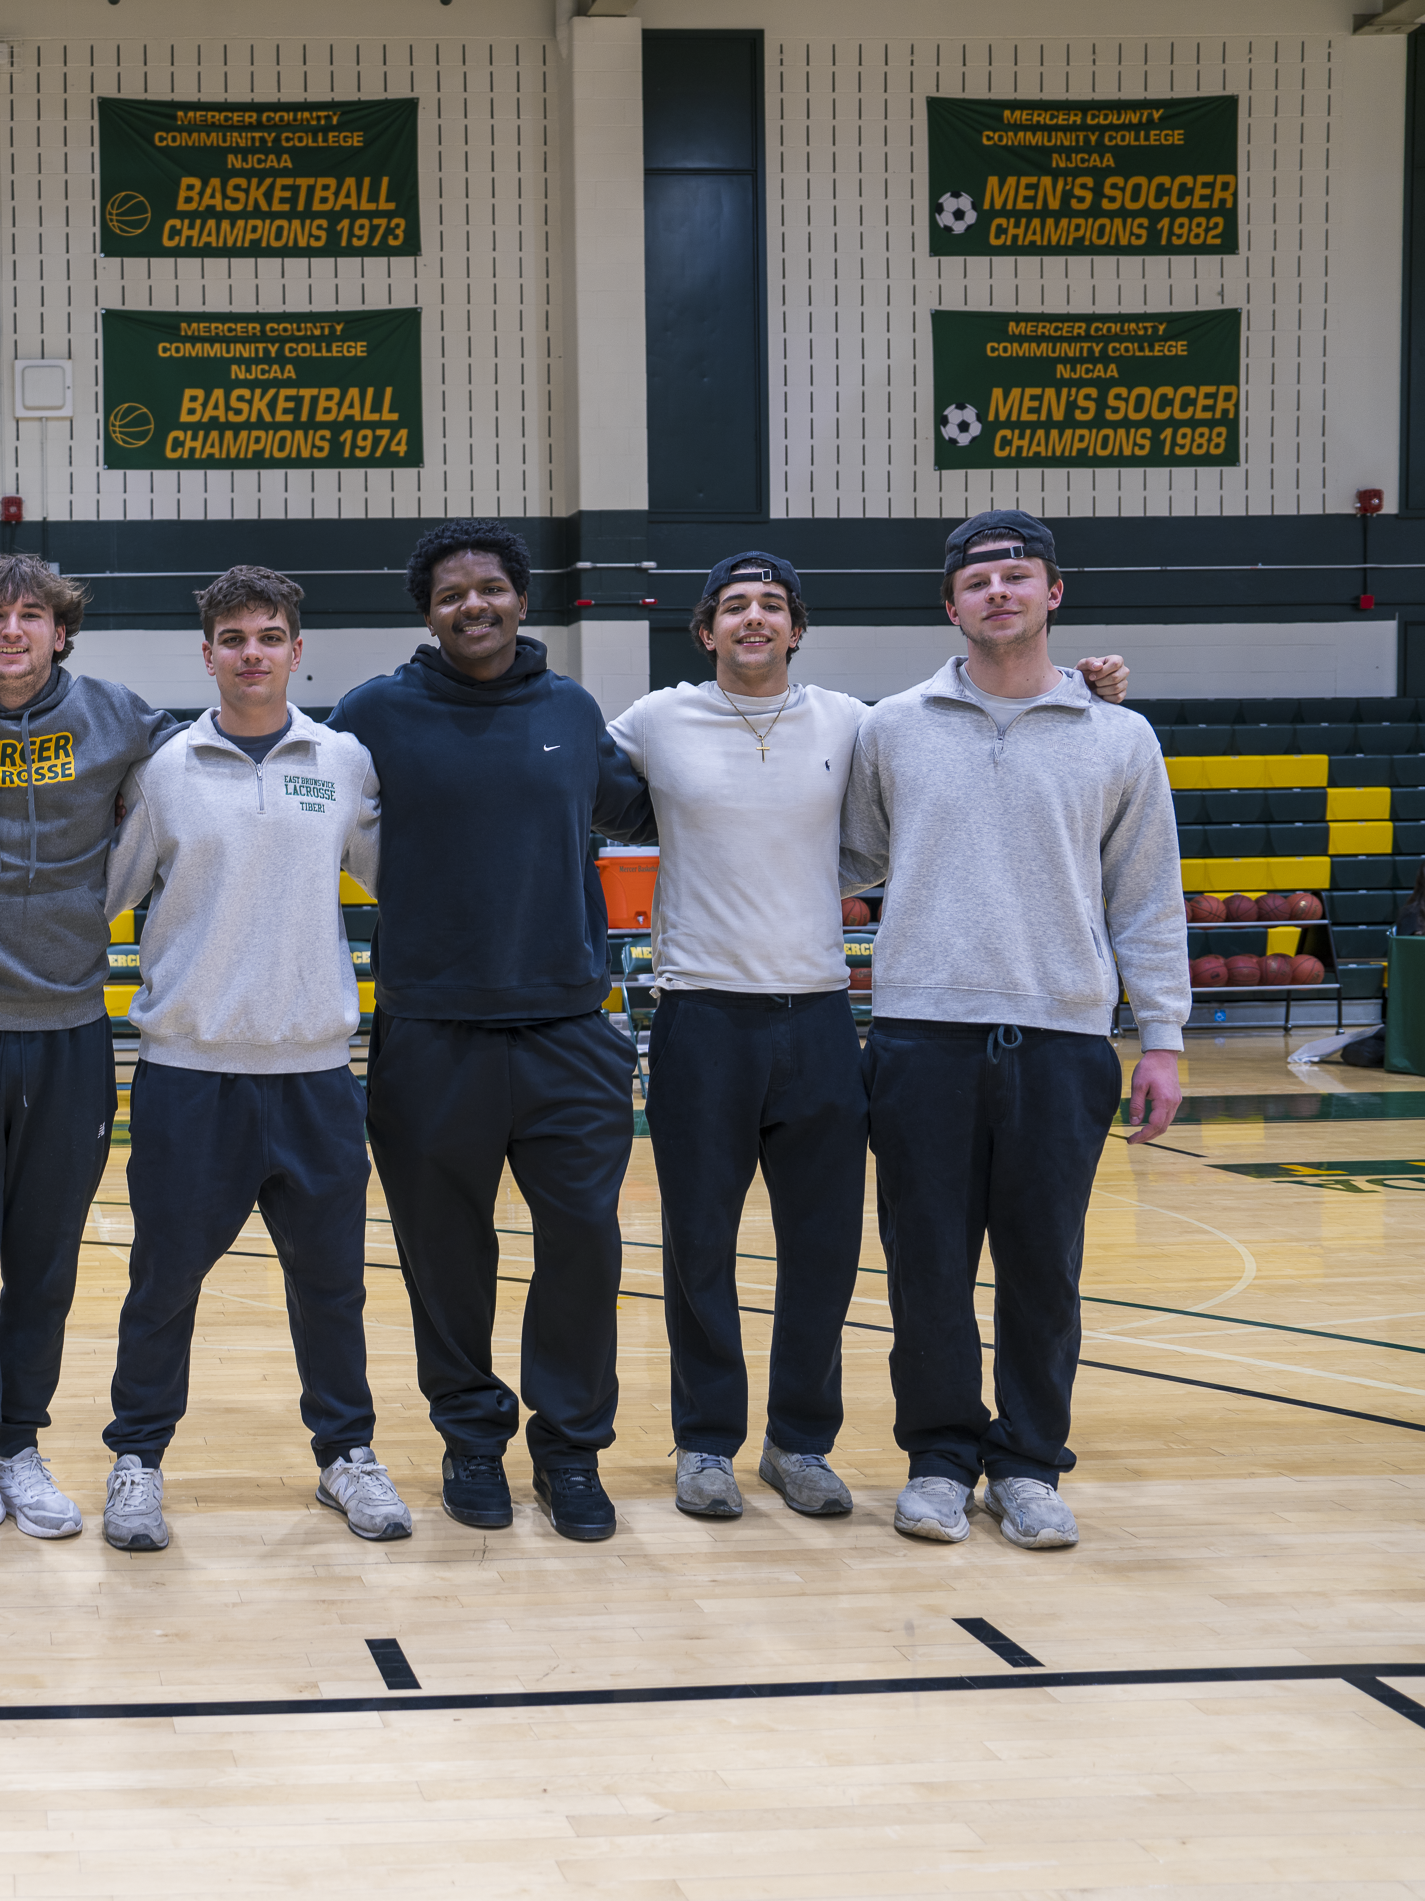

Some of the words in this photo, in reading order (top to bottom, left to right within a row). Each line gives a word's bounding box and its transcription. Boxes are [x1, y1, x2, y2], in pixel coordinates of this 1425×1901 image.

[176, 110, 258, 126] MERCER
[261, 111, 341, 126] COUNTY
[1003, 109, 1083, 125] MERCER
[1086, 108, 1164, 125] COUNTY
[154, 131, 277, 147] COMMUNITY
[280, 131, 364, 147] COLLEGE
[982, 130, 1100, 147] COMMUNITY
[1104, 129, 1185, 146] COLLEGE
[227, 153, 293, 169] NJCAA
[1051, 152, 1116, 168] NJCAA
[176, 176, 396, 212] BASKETBALL
[982, 175, 1094, 210] MEN'S
[1101, 174, 1237, 211] SOCCER
[162, 218, 328, 248] CHAMPIONS
[336, 217, 406, 247] 1973
[988, 217, 1149, 246] CHAMPIONS
[1156, 216, 1225, 246] 1982
[180, 322, 261, 337] MERCER
[265, 322, 345, 337] COUNTY
[1008, 321, 1087, 337] MERCER
[1090, 322, 1167, 337] COUNTY
[157, 342, 280, 358] COMMUNITY
[284, 341, 368, 358] COLLEGE
[986, 342, 1105, 358] COMMUNITY
[1107, 340, 1188, 357] COLLEGE
[230, 364, 297, 380] NJCAA
[1056, 363, 1119, 379] NJCAA
[179, 386, 399, 423] BASKETBALL
[987, 386, 1098, 422] MEN'S
[1104, 384, 1239, 421] SOCCER
[164, 429, 332, 459] CHAMPIONS
[339, 428, 409, 458] 1974
[993, 427, 1152, 458] CHAMPIONS
[1159, 426, 1228, 456] 1988
[284, 775, 300, 784] EAST
[301, 777, 335, 789] BRUNSWICK
[285, 784, 336, 801] LACROSSE
[619, 865, 637, 873] Mercer
